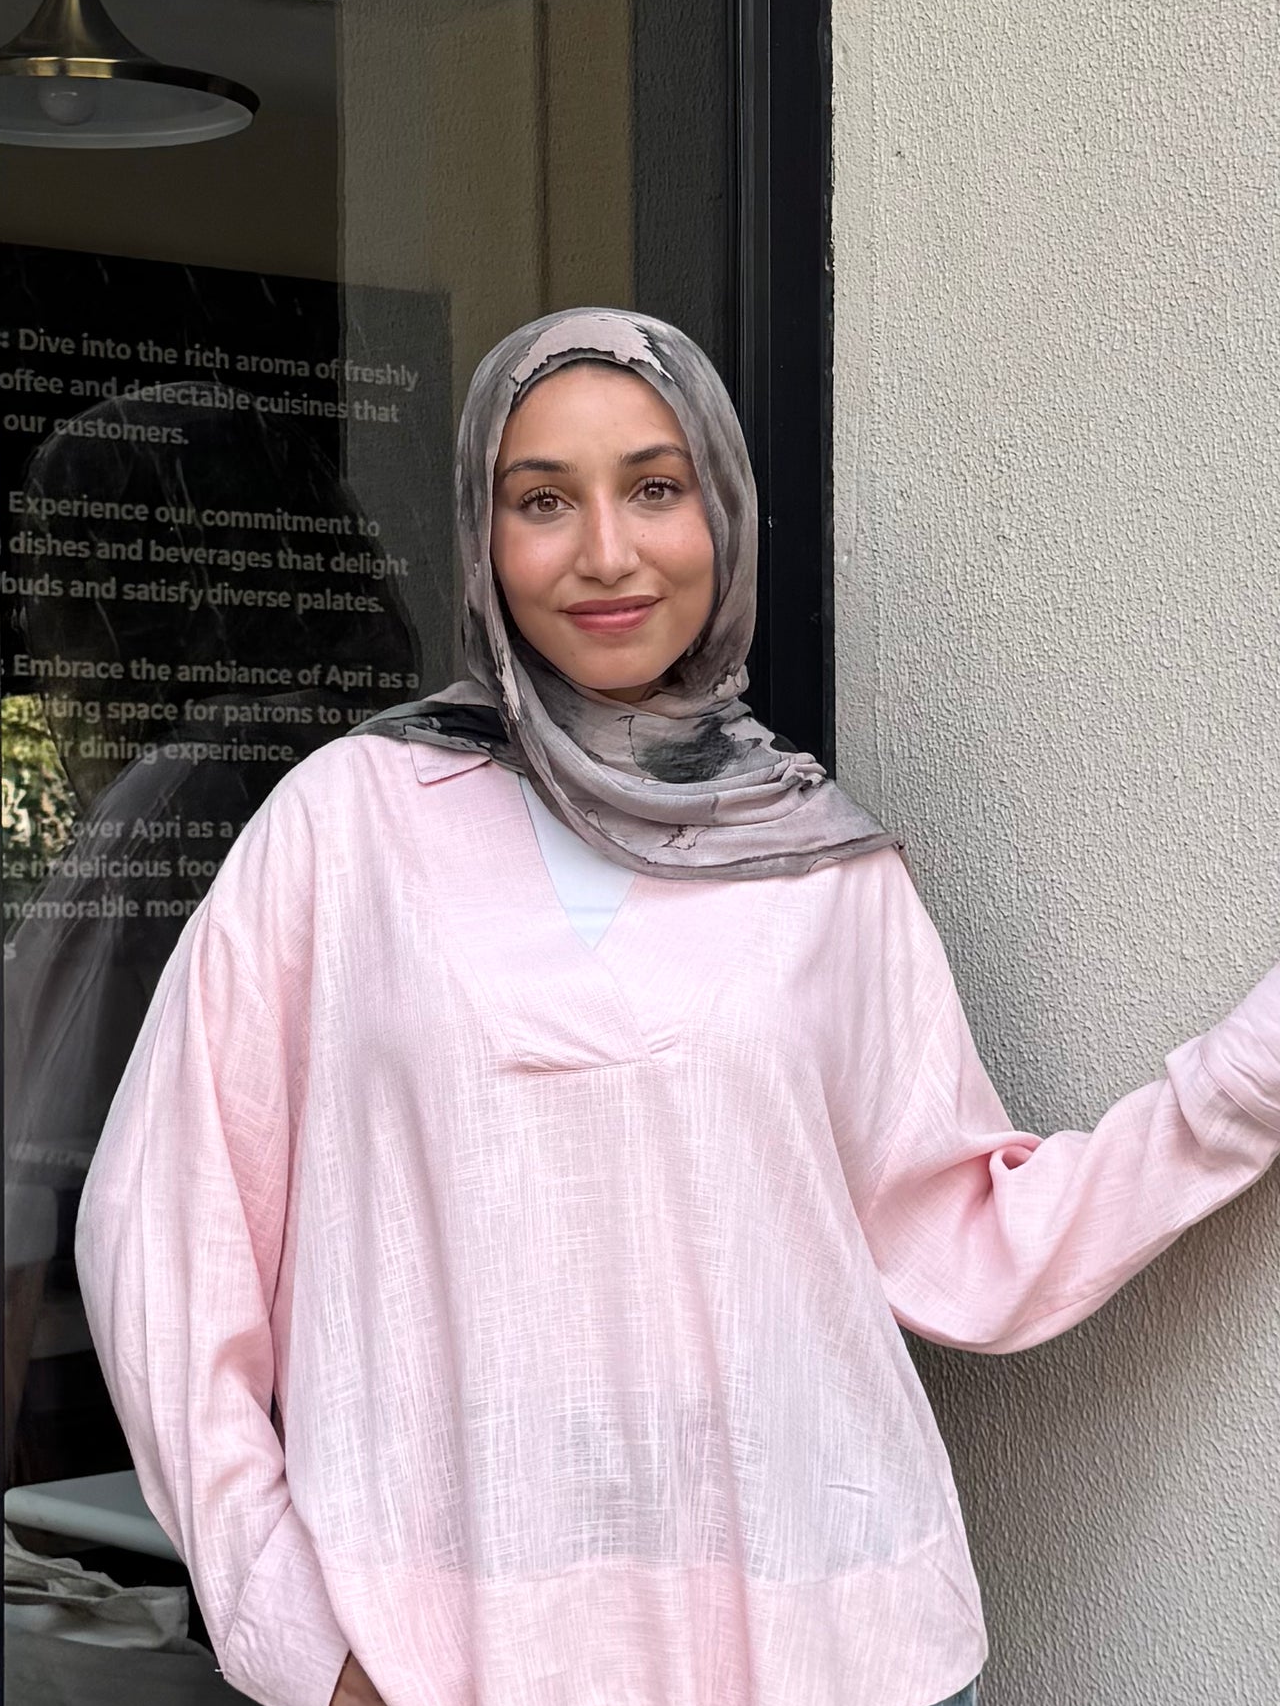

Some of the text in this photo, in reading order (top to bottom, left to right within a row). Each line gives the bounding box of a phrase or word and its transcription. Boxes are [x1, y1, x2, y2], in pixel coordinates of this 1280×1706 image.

[18, 328, 75, 356] Dive
[82, 332, 132, 361] into
[137, 339, 178, 365] the
[185, 343, 230, 369] rich
[236, 354, 310, 379] aroma
[315, 359, 344, 380] of
[344, 360, 418, 392] freshly
[0, 368, 400, 423] offee and delectable cuisines that
[2, 413, 190, 445] our customers.
[8, 491, 381, 538] Experience our commitment to
[8, 531, 409, 580] dishes and beverages that delight
[0, 571, 385, 617] buds and satisfy diverse palates.
[12, 657, 124, 679] Embrace
[130, 661, 172, 682] the
[176, 660, 292, 686] ambiance
[297, 664, 323, 686] of
[326, 665, 373, 692] Apri
[378, 671, 404, 689] as
[405, 671, 420, 689] a
[107, 701, 179, 727] space
[184, 699, 218, 722] for
[224, 704, 312, 727] patrons
[316, 705, 342, 725] to
[80, 735, 156, 765] dining
[164, 737, 300, 765] experience.
[132, 815, 181, 845] Apri
[187, 819, 216, 839] as
[219, 819, 234, 839] a
[64, 855, 172, 879] delicious
[178, 855, 222, 879] foo
